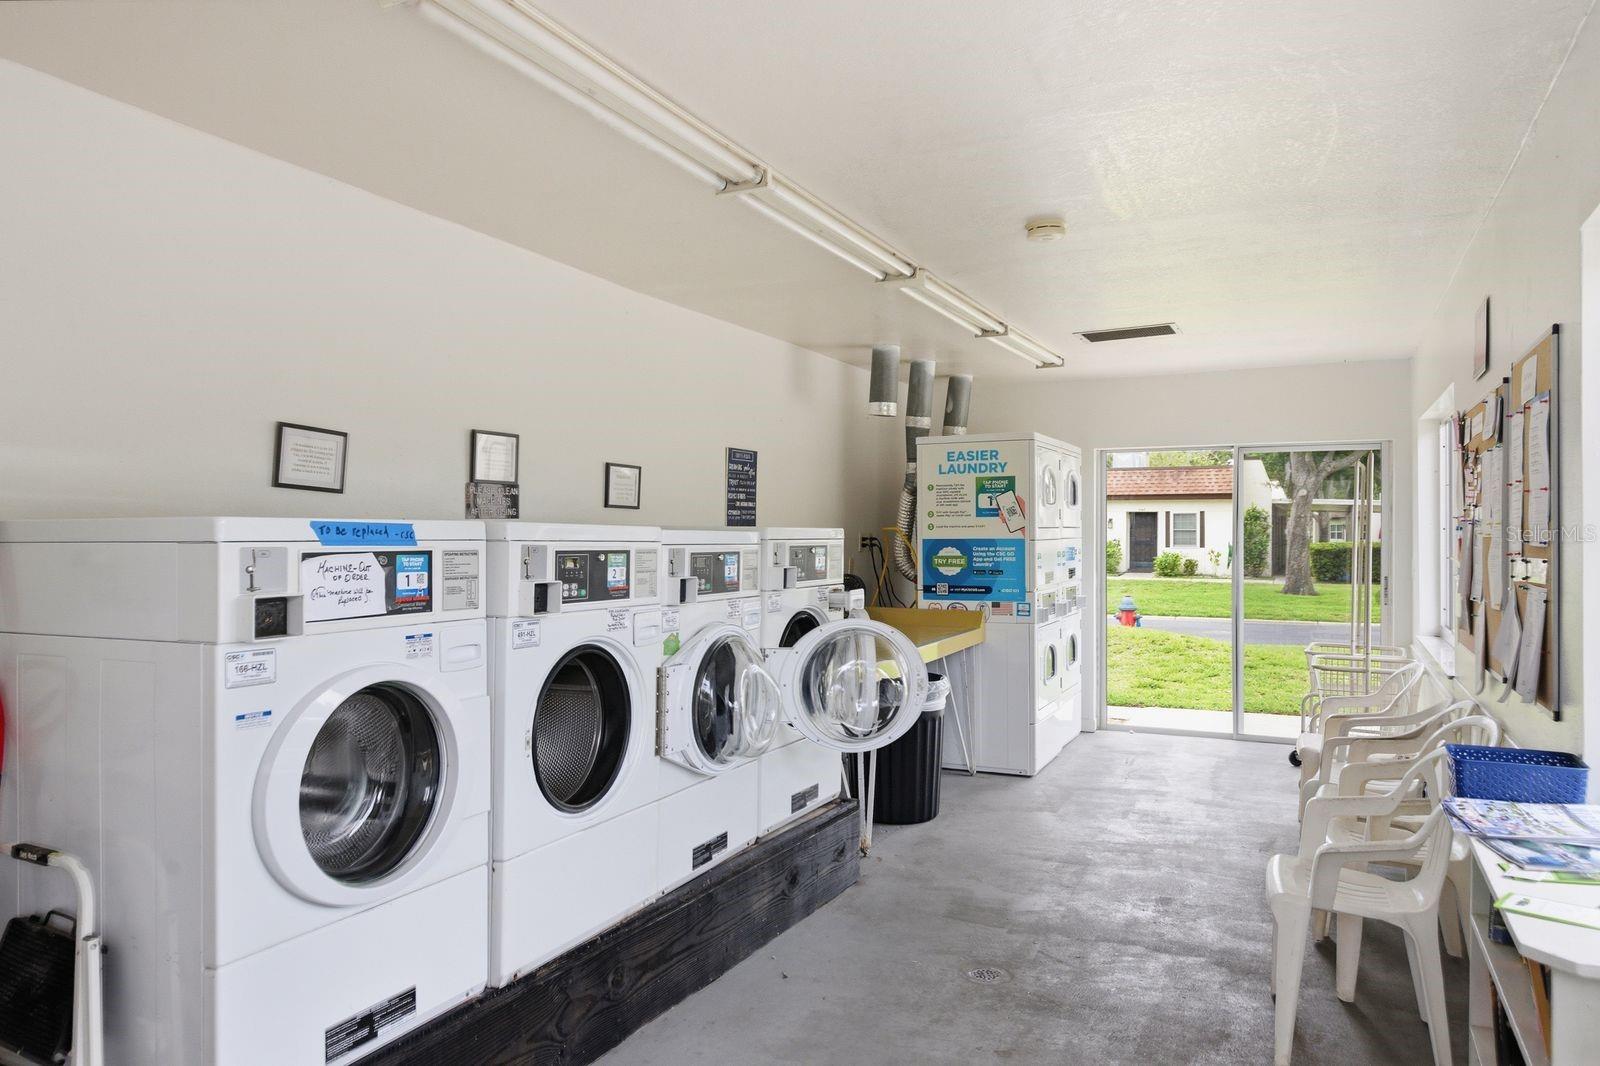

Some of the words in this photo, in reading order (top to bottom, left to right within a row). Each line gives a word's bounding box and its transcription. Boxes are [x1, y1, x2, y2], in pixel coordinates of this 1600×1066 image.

[947, 449, 999, 462] EASIER
[938, 461, 1008, 475] LAUNDRY
[470, 484, 496, 495] PLEASE
[497, 486, 519, 495] CLEAN
[471, 507, 494, 516] AFTER
[496, 508, 516, 516] USING
[352, 525, 389, 539] replaced
[344, 573, 369, 582] ORDER
[612, 569, 617, 579] 2
[405, 574, 410, 587] 1
